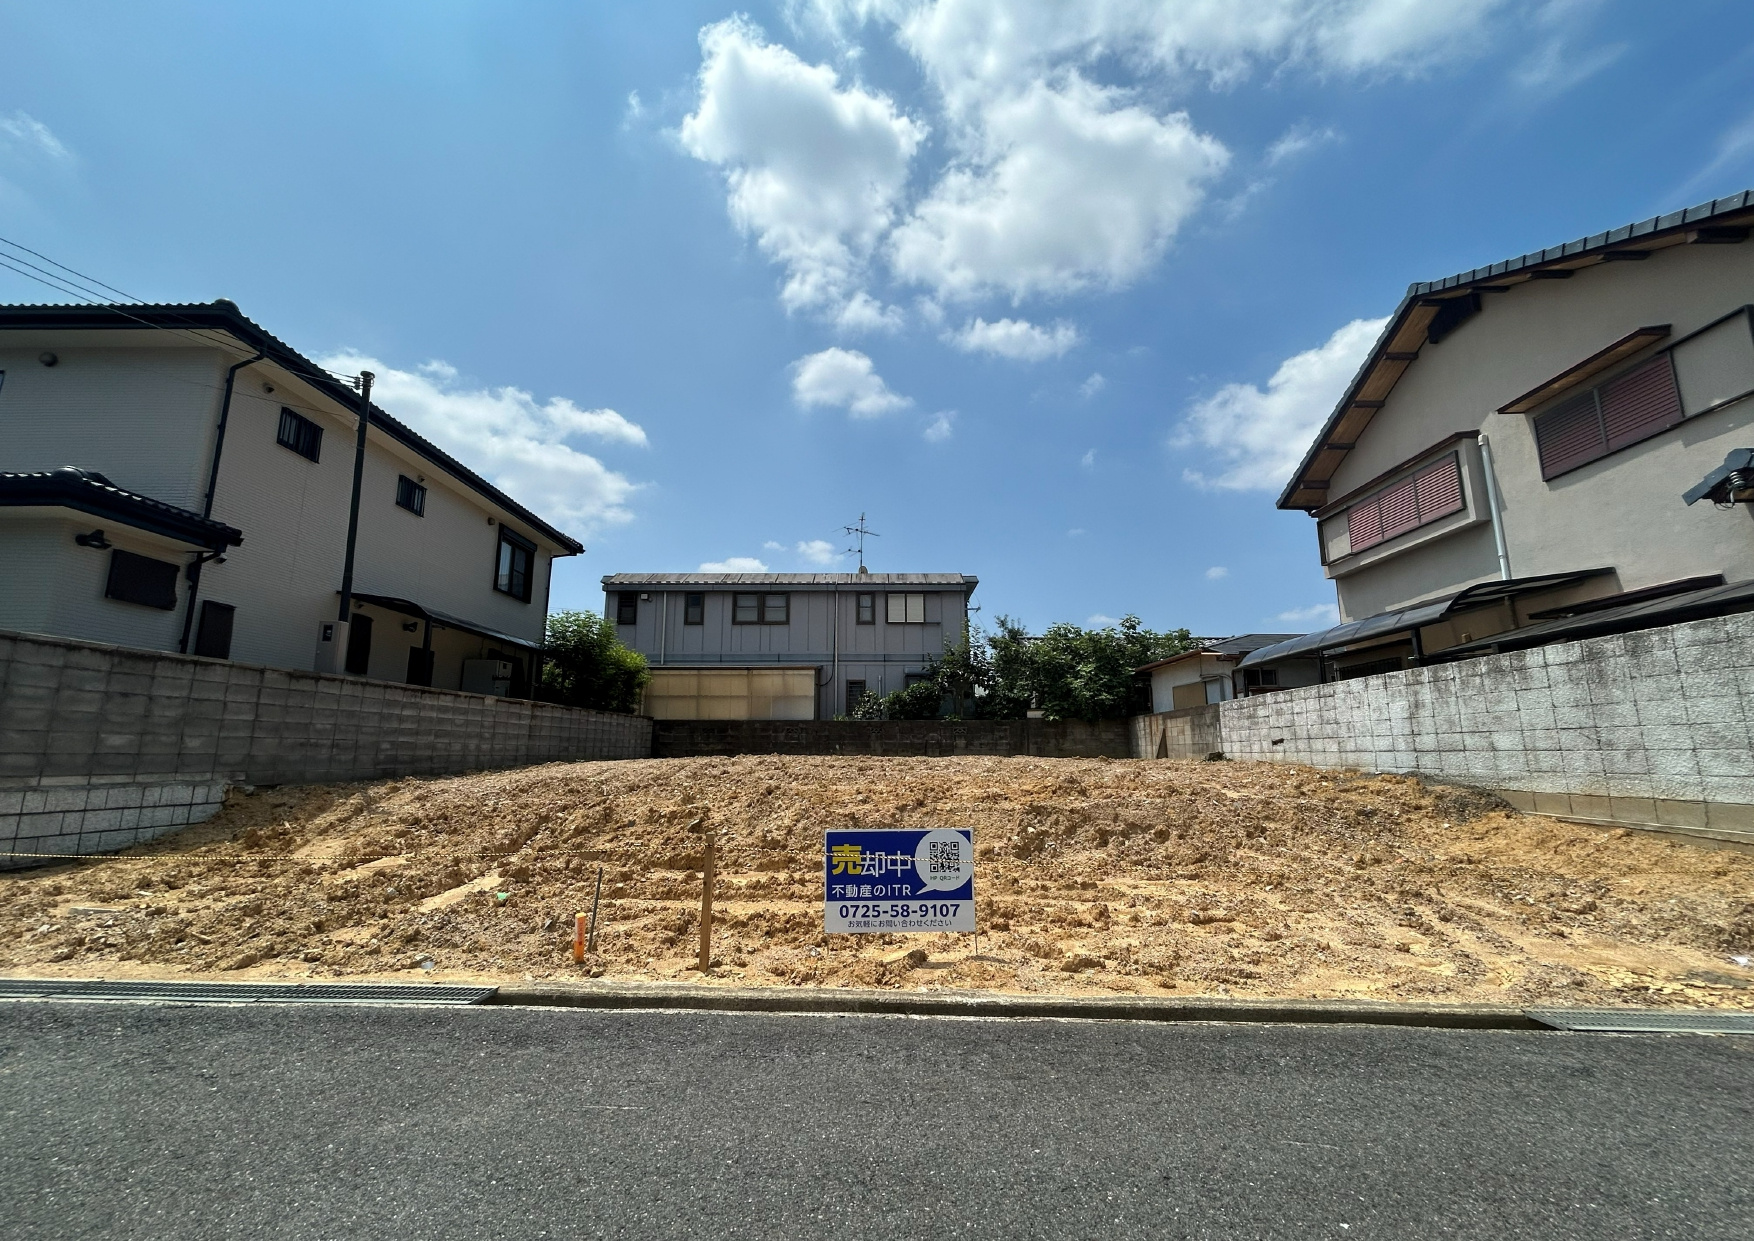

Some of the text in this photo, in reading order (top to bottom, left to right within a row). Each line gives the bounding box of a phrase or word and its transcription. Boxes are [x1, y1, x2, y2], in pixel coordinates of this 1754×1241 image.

[831, 844, 911, 877] 売却中
[831, 884, 912, 898] 不動産のITR
[839, 903, 960, 918] 0725-58-9107
[848, 920, 952, 928] お気軽にお問い合わせください
